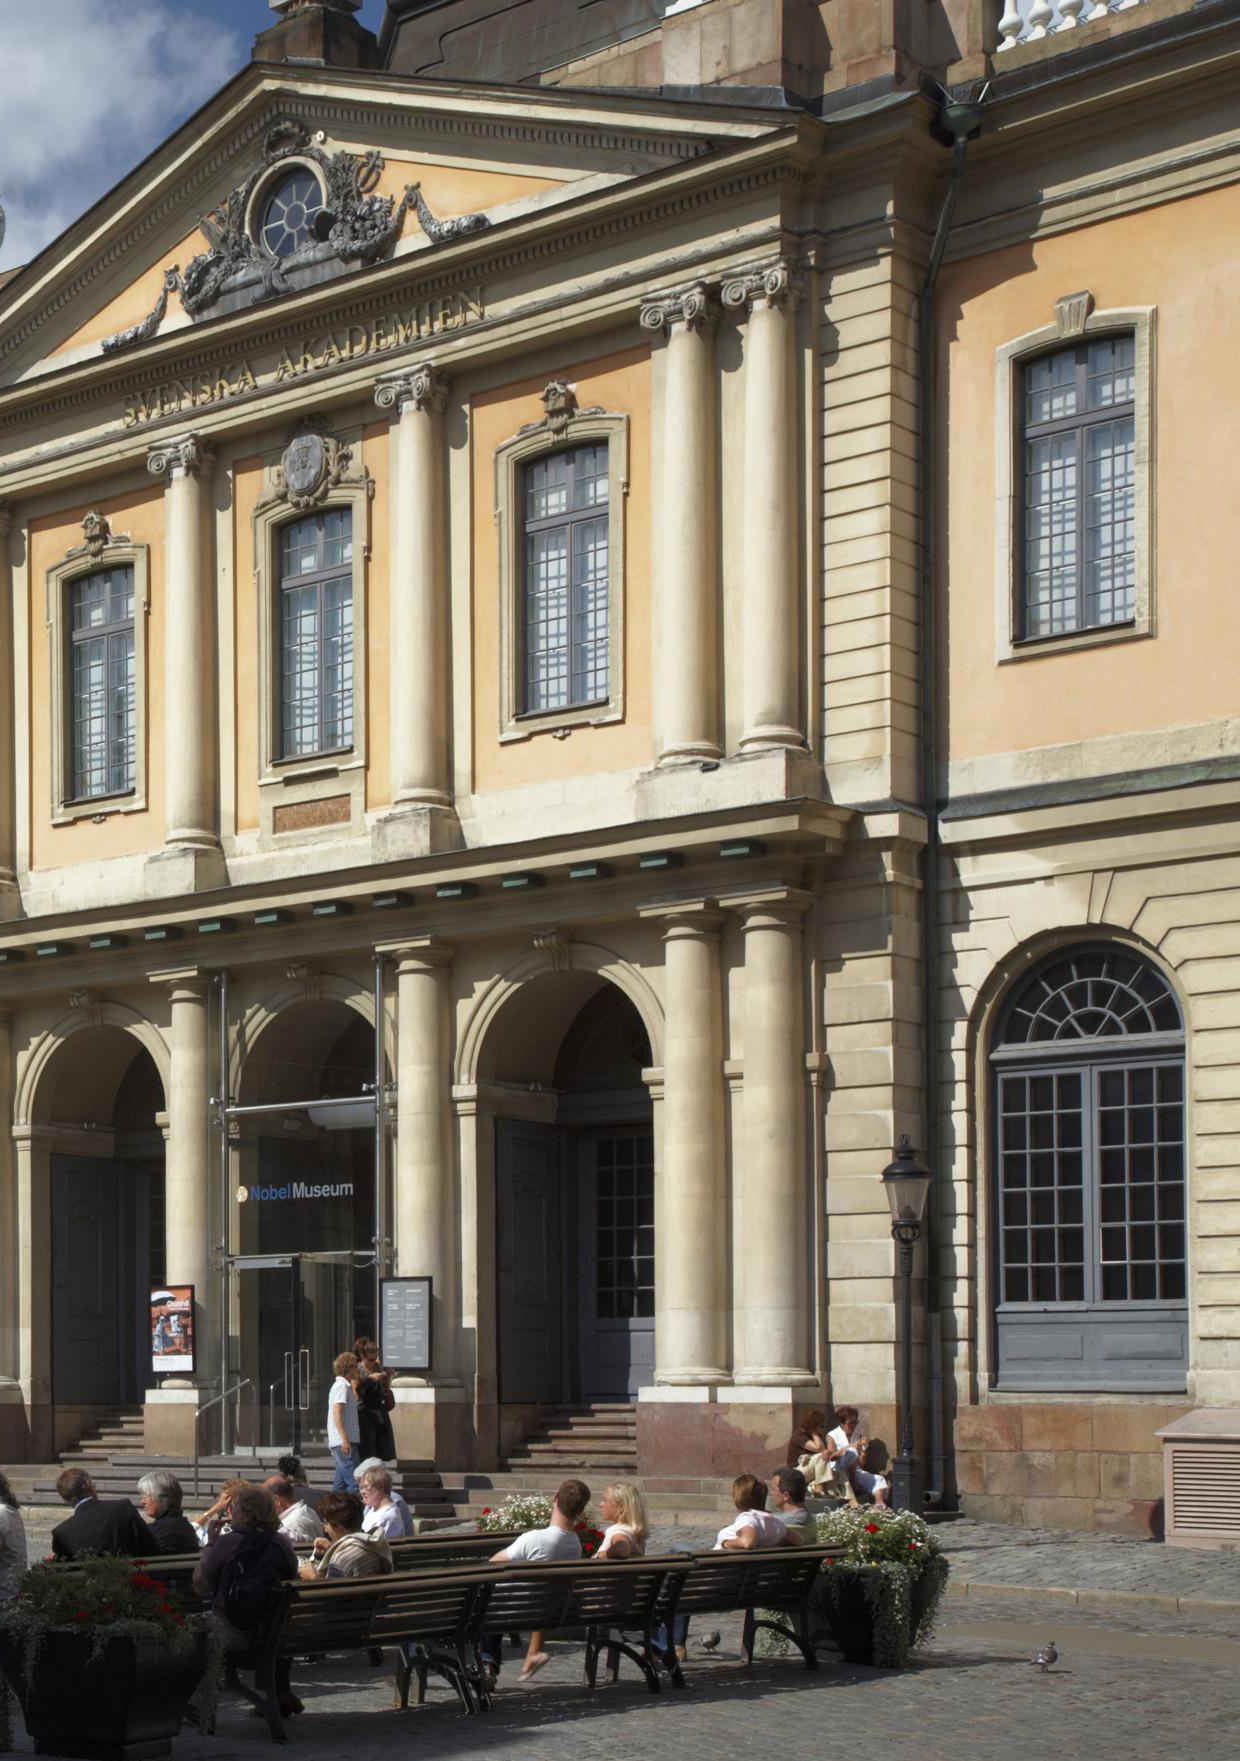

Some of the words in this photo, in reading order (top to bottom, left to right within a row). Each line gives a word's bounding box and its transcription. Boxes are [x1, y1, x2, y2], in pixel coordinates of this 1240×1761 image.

[121, 360, 258, 428] SVENSKA
[274, 286, 485, 381] AKADEMIEN
[250, 1183, 291, 1200] Nobel
[292, 1181, 353, 1198] Museum
